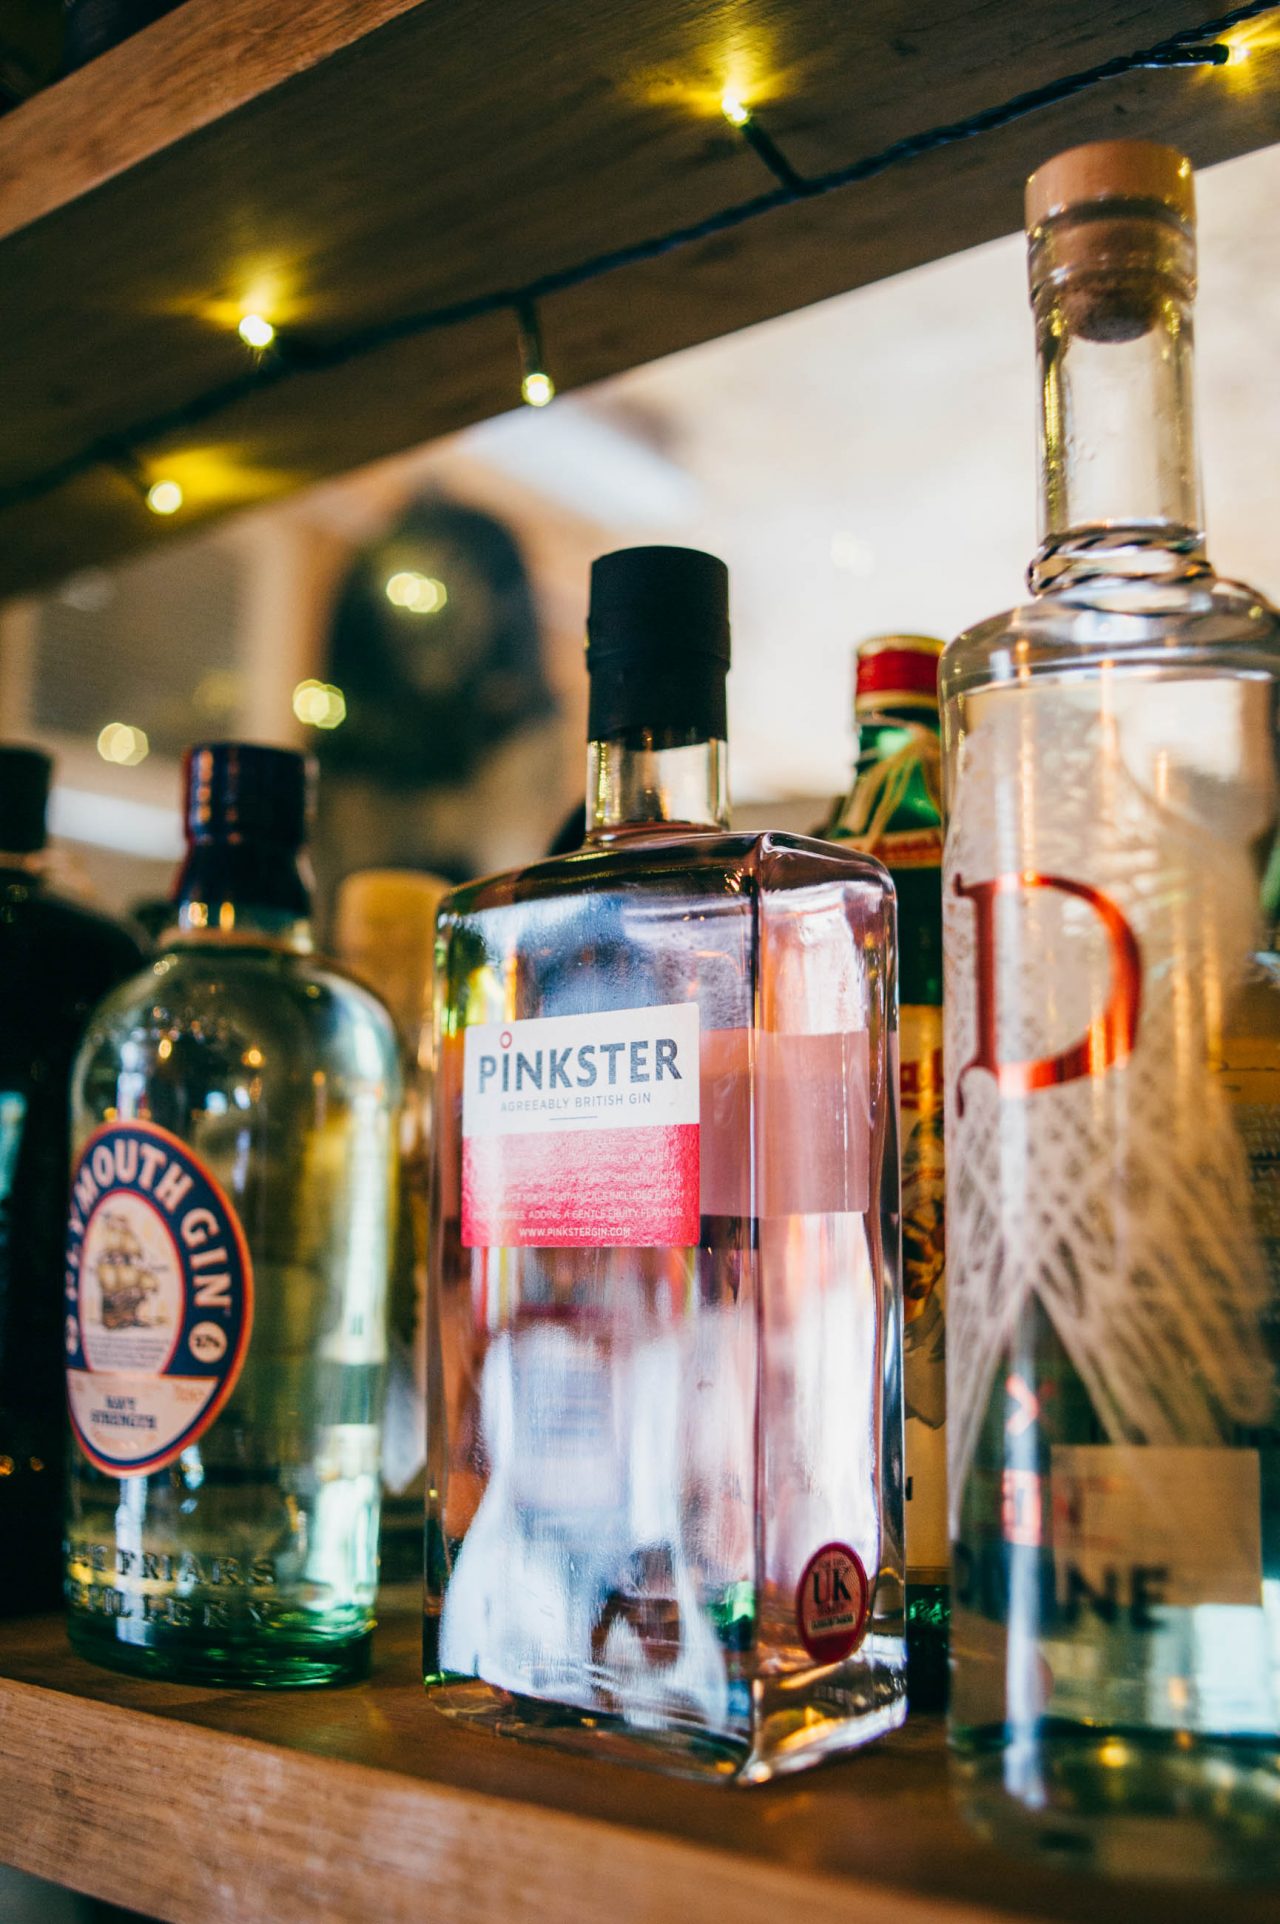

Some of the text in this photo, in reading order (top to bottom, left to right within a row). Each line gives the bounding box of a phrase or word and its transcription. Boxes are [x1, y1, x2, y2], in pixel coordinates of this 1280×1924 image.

[478, 1035, 683, 1094] PINKSTER
[501, 1093, 651, 1112] AGREEABLY BRITISH GIN
[180, 1207, 233, 1308] GIN
